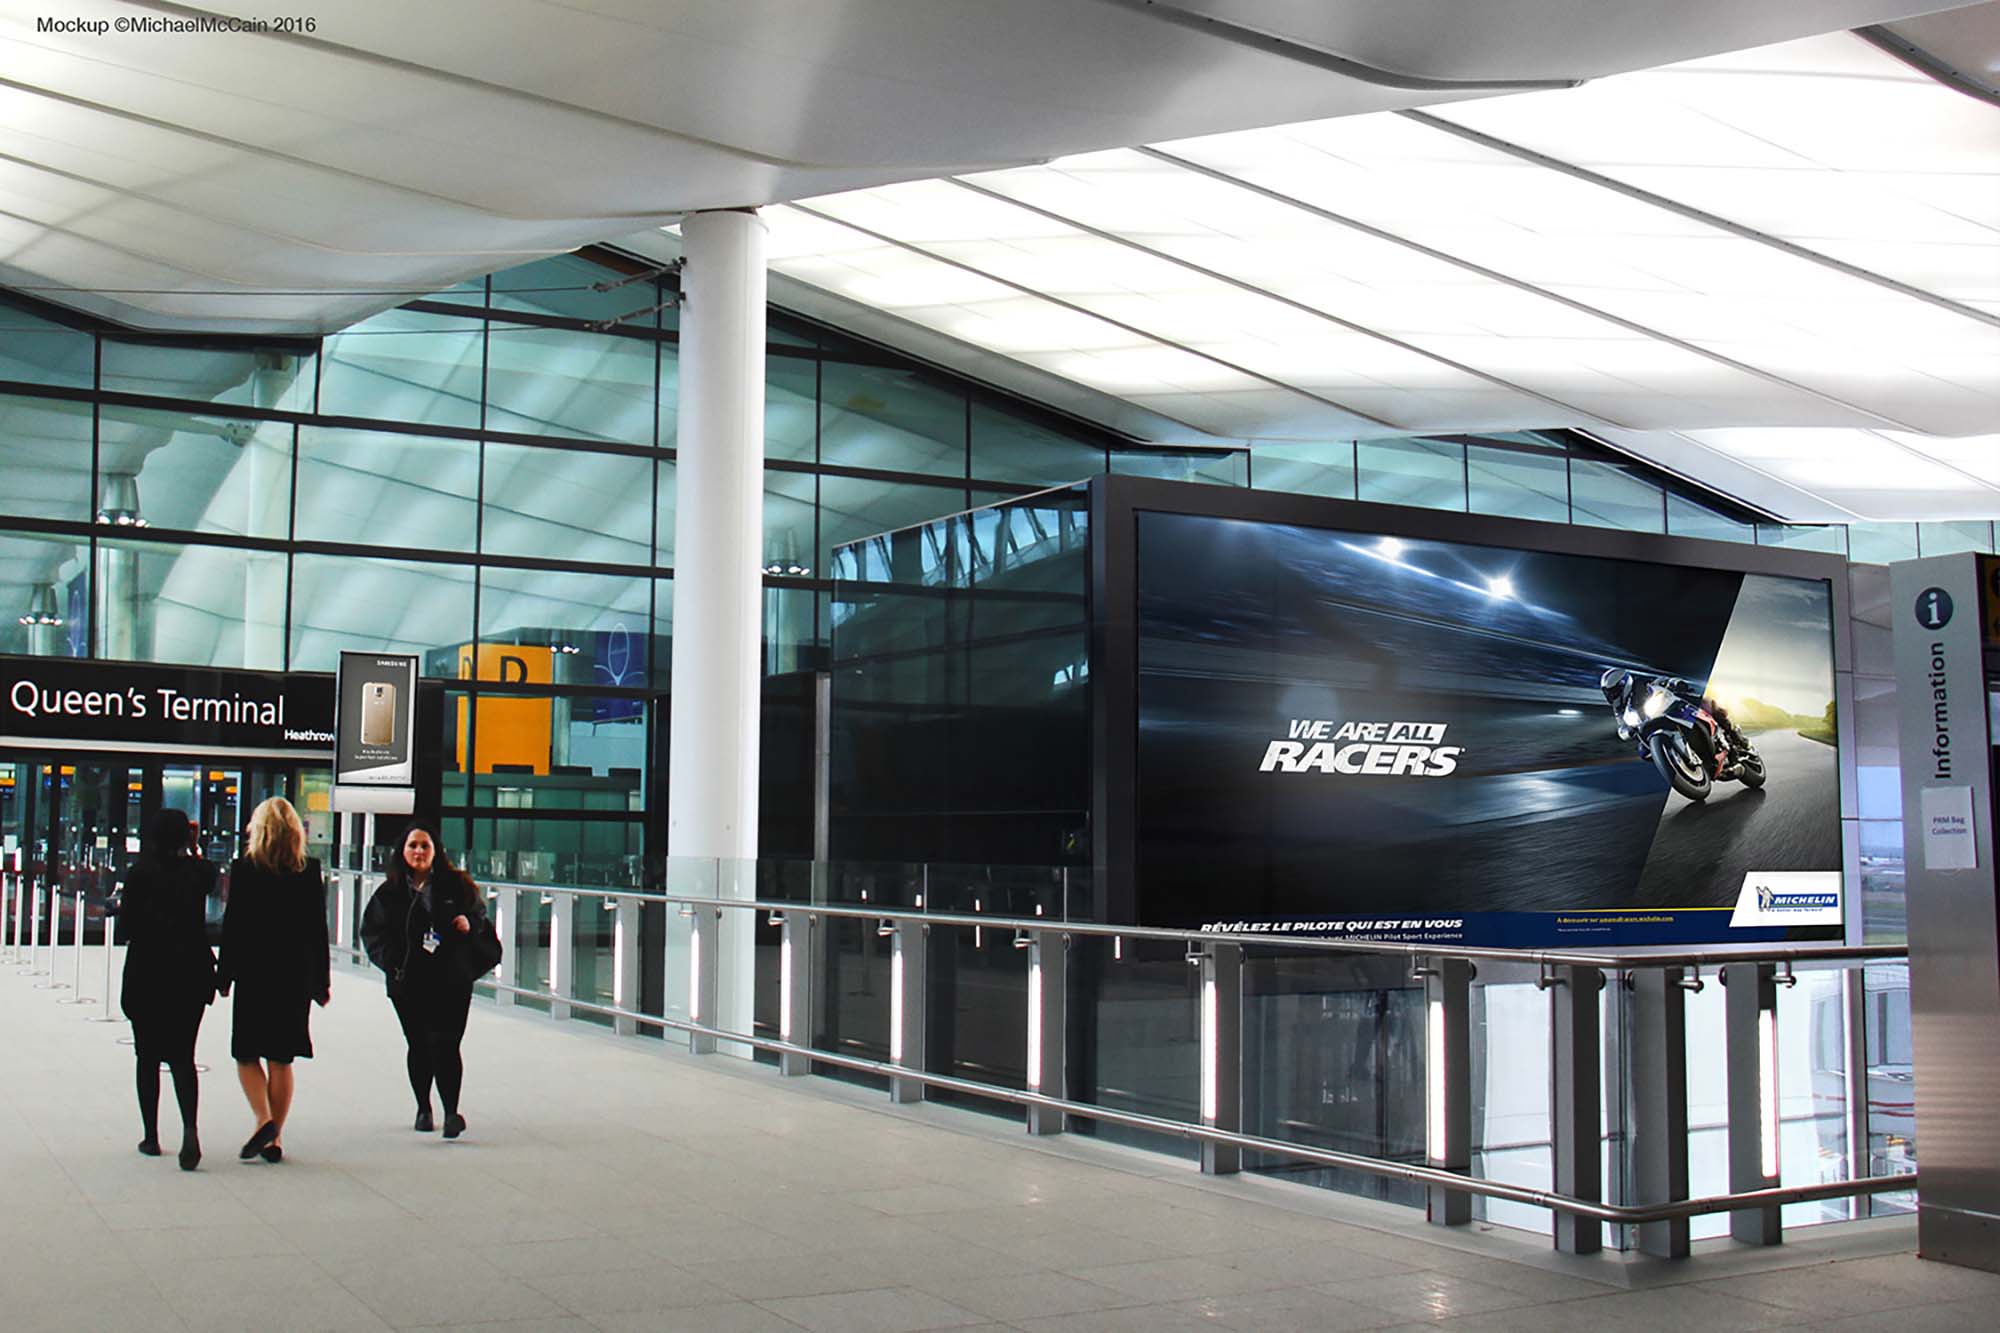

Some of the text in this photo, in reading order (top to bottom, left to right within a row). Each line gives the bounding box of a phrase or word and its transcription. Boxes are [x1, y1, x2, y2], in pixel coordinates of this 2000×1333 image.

[157, 688, 284, 726] Terminal
[1928, 642, 1951, 779] Information
[1288, 719, 1437, 742] WE ARE ALL
[1258, 740, 1462, 777] RACERS
[1774, 895, 1836, 905] MICHELIN
[1199, 919, 1463, 933] RÉVÉLEZ LE PILOTE QUI EST EN VOUS
[1424, 932, 1463, 940] Experience
